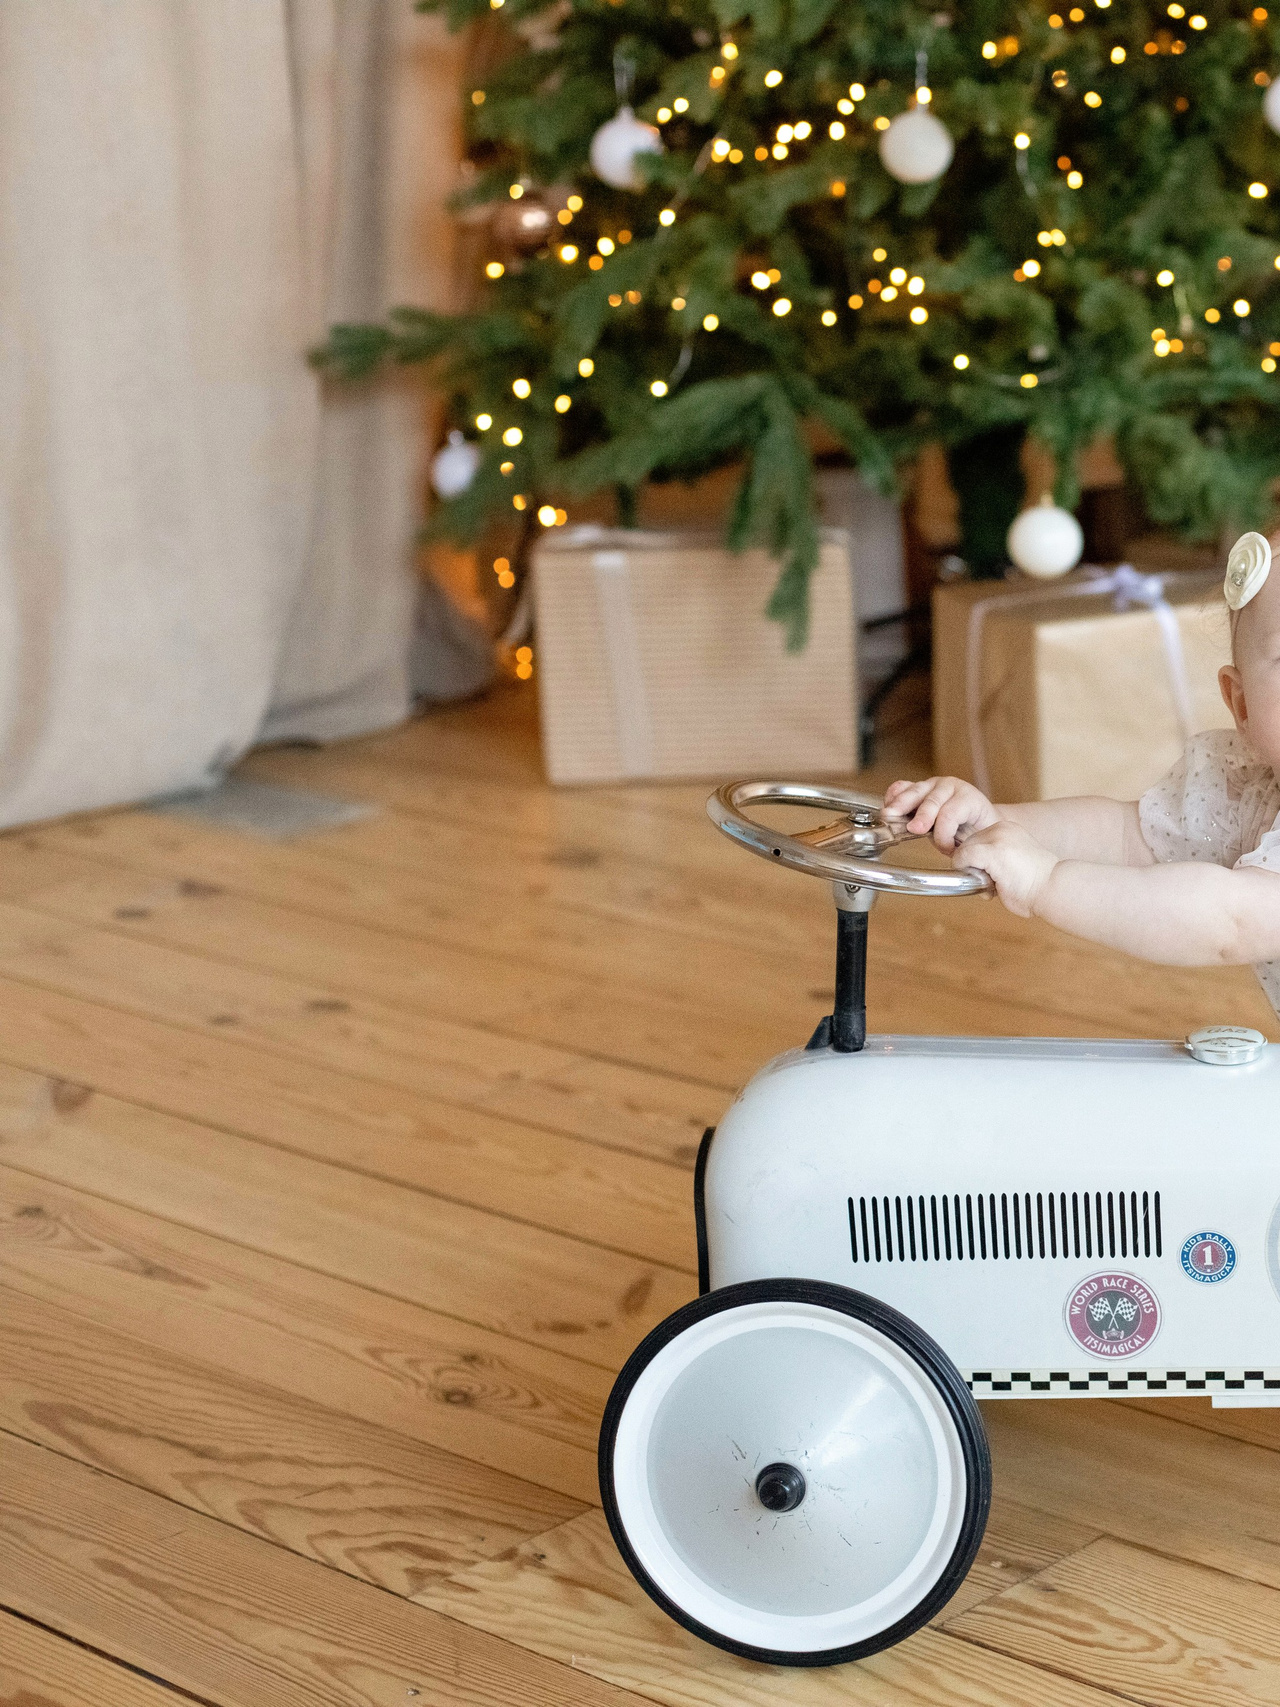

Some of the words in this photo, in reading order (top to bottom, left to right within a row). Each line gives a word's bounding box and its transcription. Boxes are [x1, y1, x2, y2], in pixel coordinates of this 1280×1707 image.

[1183, 1234, 1203, 1253] KIDS
[1206, 1233, 1233, 1252] RALLY
[1202, 1245, 1214, 1266] 1
[1182, 1260, 1234, 1282] ITSIMAGICAL
[1071, 1282, 1098, 1315] WORLD
[1102, 1277, 1128, 1289] RACE
[1129, 1284, 1155, 1315] SERIES
[1083, 1334, 1146, 1356] ITSIMAGICAL
